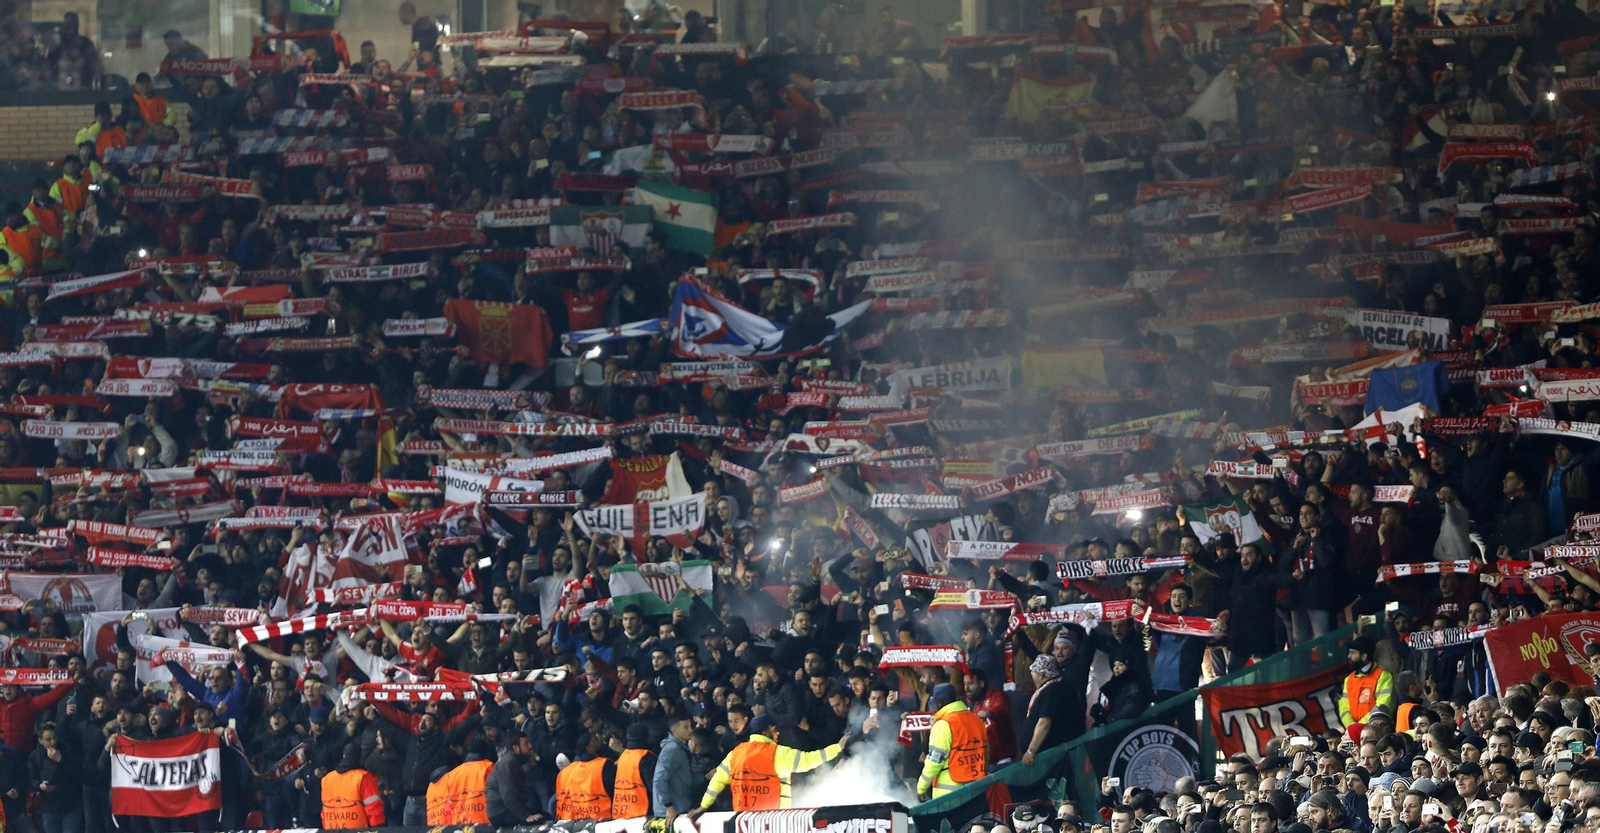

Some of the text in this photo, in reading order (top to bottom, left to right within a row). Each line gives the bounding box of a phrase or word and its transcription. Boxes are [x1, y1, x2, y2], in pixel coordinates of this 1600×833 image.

[288, 152, 323, 165] SEVILLA
[390, 165, 425, 177] SEVILLA
[133, 187, 175, 198] Sevilla
[529, 248, 572, 257] SEVILLA
[858, 257, 924, 271] SUPERCOPA
[332, 264, 420, 278] ULTRAS BIRIS
[873, 273, 932, 288] SUPERCOPA
[1362, 312, 1425, 327] SEVILLISTAS DE
[674, 364, 703, 372] SEVILLA
[908, 367, 1000, 388] LEBRIJA
[1301, 383, 1349, 397] SEVILLA
[791, 394, 823, 404] SEVILLA
[1432, 418, 1470, 427] SEVILLA
[300, 425, 318, 433] 2005
[251, 440, 266, 448] POR
[268, 440, 278, 448] LA
[404, 438, 440, 450] BIRIS
[198, 451, 228, 459] SEVILLA
[257, 452, 275, 460] CLUB
[893, 447, 910, 455] WE
[819, 455, 853, 468] HERE
[1209, 460, 1274, 475] ULTRAS BIRI
[974, 479, 1004, 497] IRIS
[582, 500, 700, 531] GUILLENA
[76, 521, 87, 530] MI
[114, 552, 128, 560] QUE
[1060, 558, 1147, 578] BIRIS NORTE
[377, 603, 398, 616] FINAL
[399, 605, 417, 617] COPA
[428, 607, 444, 617] DEL
[1028, 611, 1070, 623] SEVILLA
[1561, 620, 1579, 631] HERE
[1410, 631, 1435, 649] BIRIS
[1119, 732, 1176, 762] TOP BOYS
[124, 754, 208, 785] SALTERAS
[732, 785, 770, 795] STWARD
